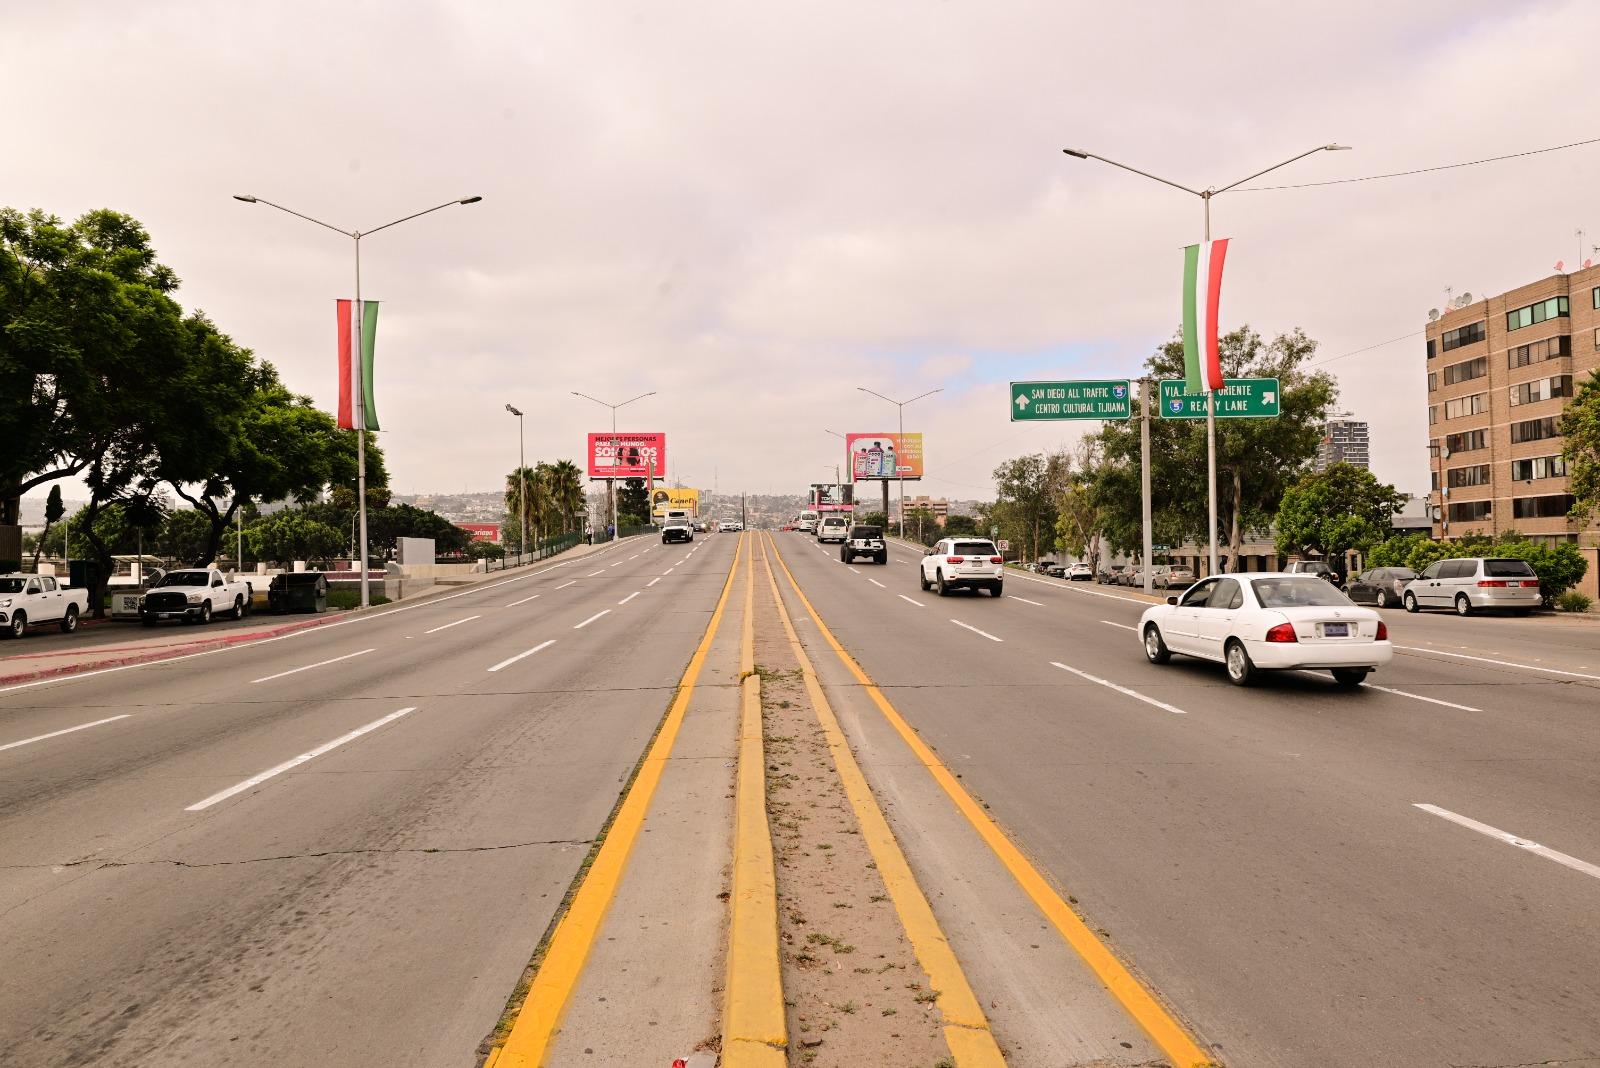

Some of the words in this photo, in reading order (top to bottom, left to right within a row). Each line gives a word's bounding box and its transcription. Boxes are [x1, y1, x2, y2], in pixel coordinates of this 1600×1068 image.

[1031, 388, 1045, 399] SAN
[1047, 388, 1065, 399] DIEGO
[1068, 388, 1080, 398] ALL
[1083, 387, 1109, 398] TRAFFIC
[1164, 386, 1179, 397] VIA
[1218, 385, 1252, 396] ORIENTE
[1035, 403, 1060, 414] CENTRO
[1063, 403, 1095, 413] CULTURAL
[1098, 402, 1126, 412] TIJUANA
[1190, 400, 1221, 412] REAY
[1225, 400, 1248, 411] LANE
